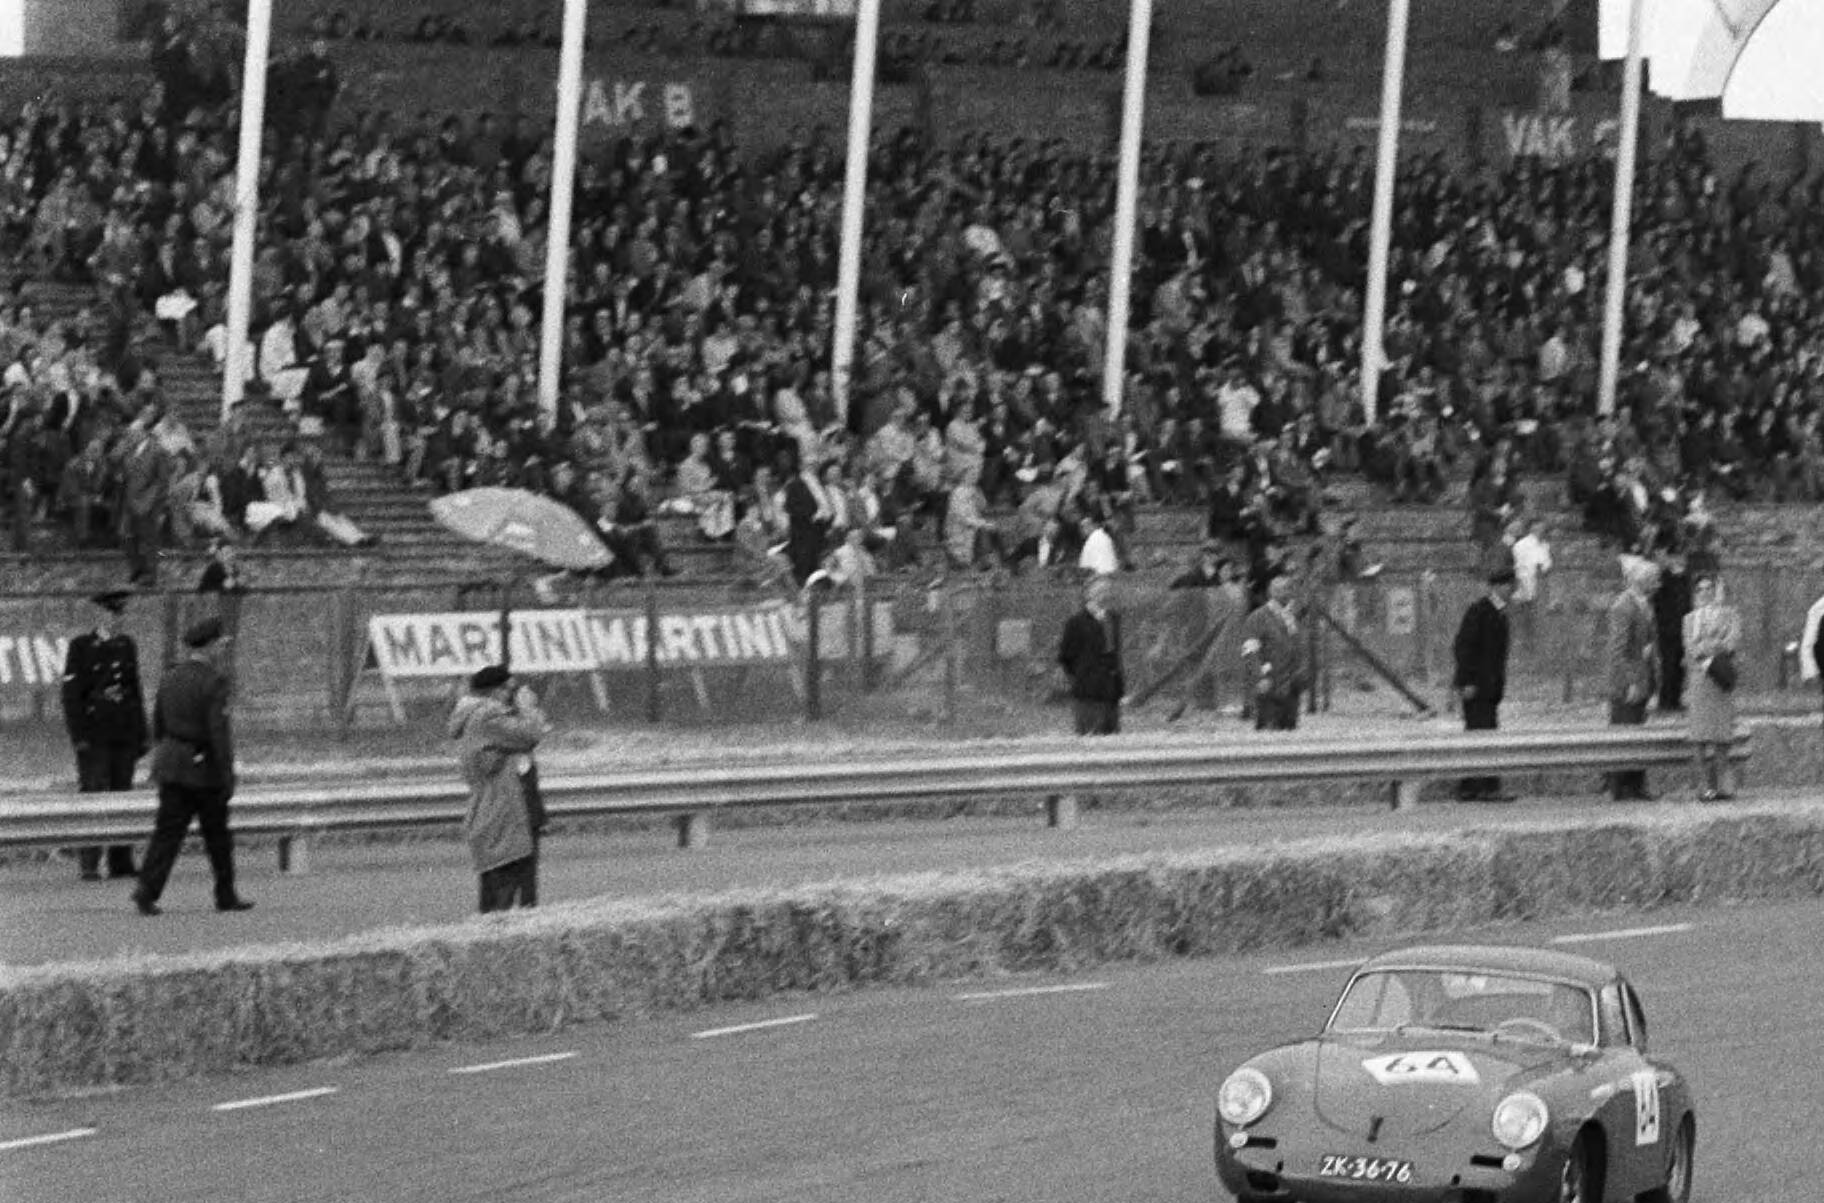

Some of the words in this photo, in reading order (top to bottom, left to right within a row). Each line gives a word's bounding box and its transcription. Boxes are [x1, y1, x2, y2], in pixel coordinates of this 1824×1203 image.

[580, 80, 646, 126] AK
[664, 82, 693, 128] B
[1502, 113, 1575, 158] VAK
[0, 635, 68, 684] TIN
